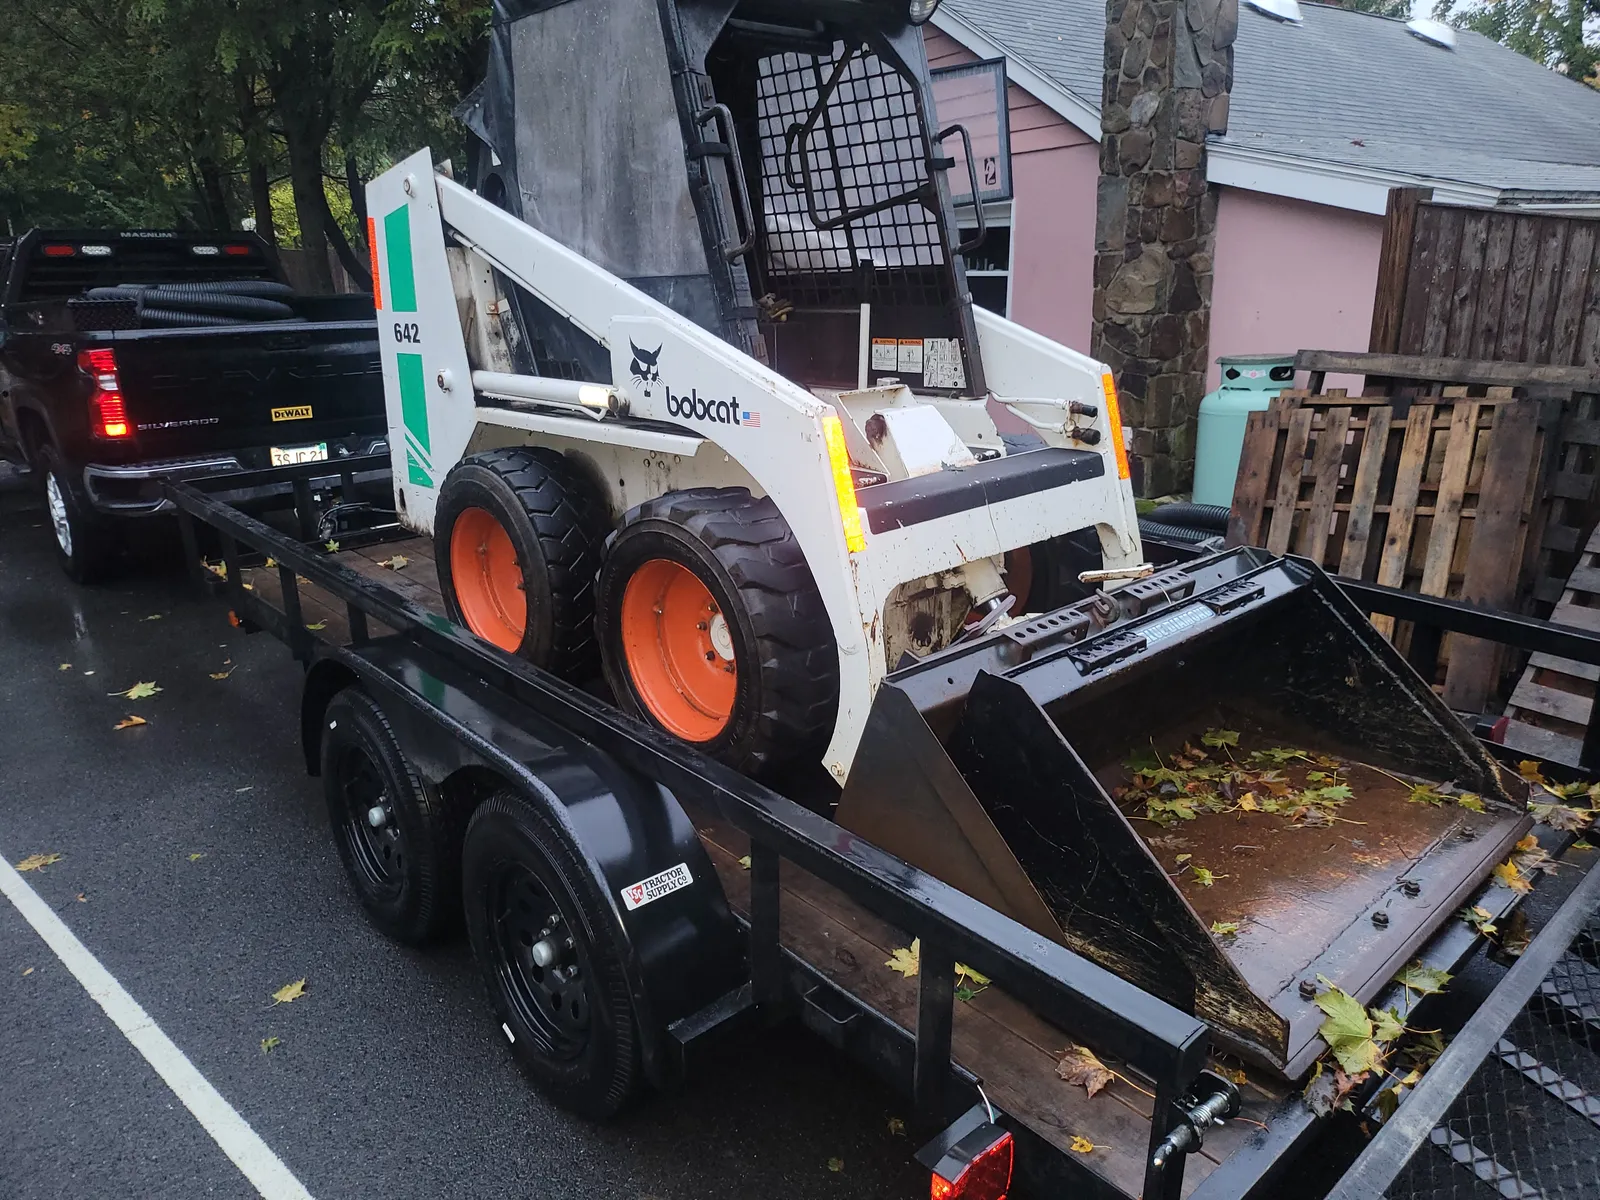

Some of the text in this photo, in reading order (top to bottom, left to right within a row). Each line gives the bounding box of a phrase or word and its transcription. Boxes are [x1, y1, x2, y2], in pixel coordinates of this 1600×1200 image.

[394, 322, 421, 343] 642
[665, 386, 740, 425] bobcat
[137, 417, 219, 430] SILVERADO
[642, 867, 684, 890] TRACTOR
[646, 879, 677, 900] SUPPLY
